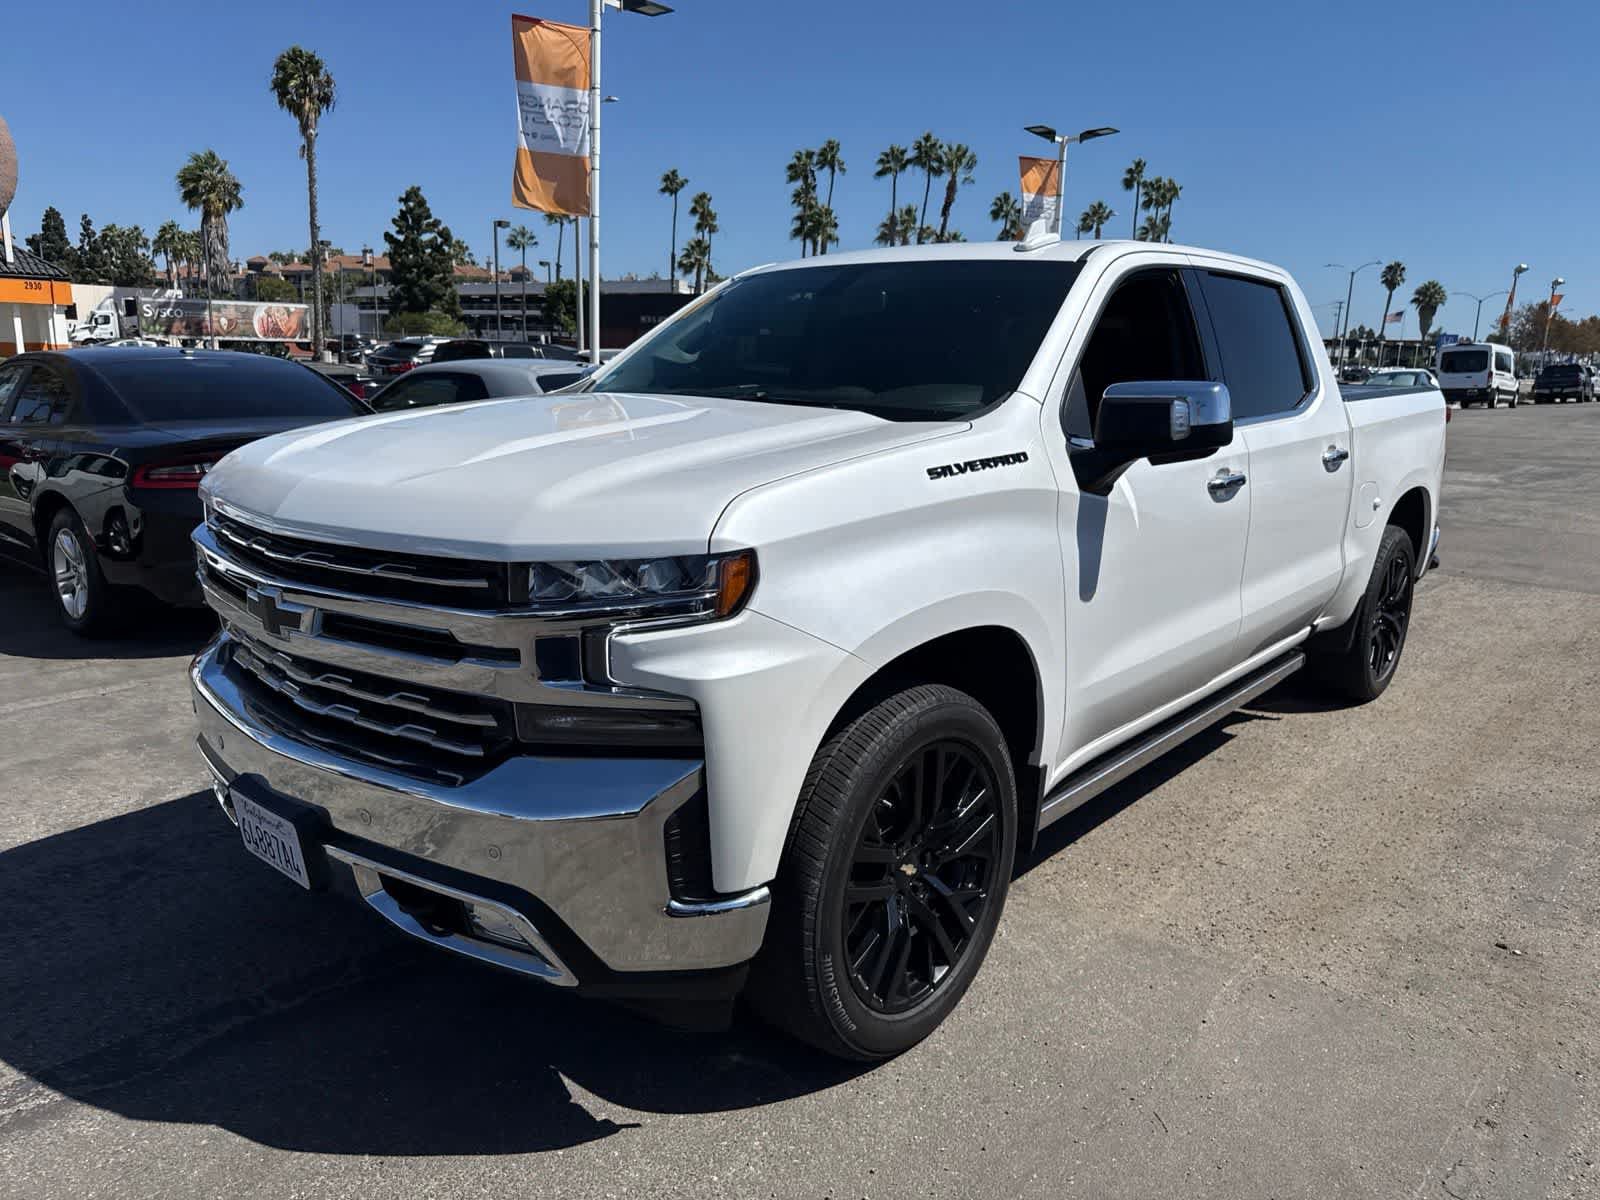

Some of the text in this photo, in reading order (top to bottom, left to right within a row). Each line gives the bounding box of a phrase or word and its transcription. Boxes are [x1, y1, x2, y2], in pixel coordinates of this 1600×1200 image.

[24, 281, 42, 291] 2930
[142, 303, 184, 320] Sysco
[926, 451, 1029, 480] SILVERADO
[242, 816, 302, 877] 64887A4
